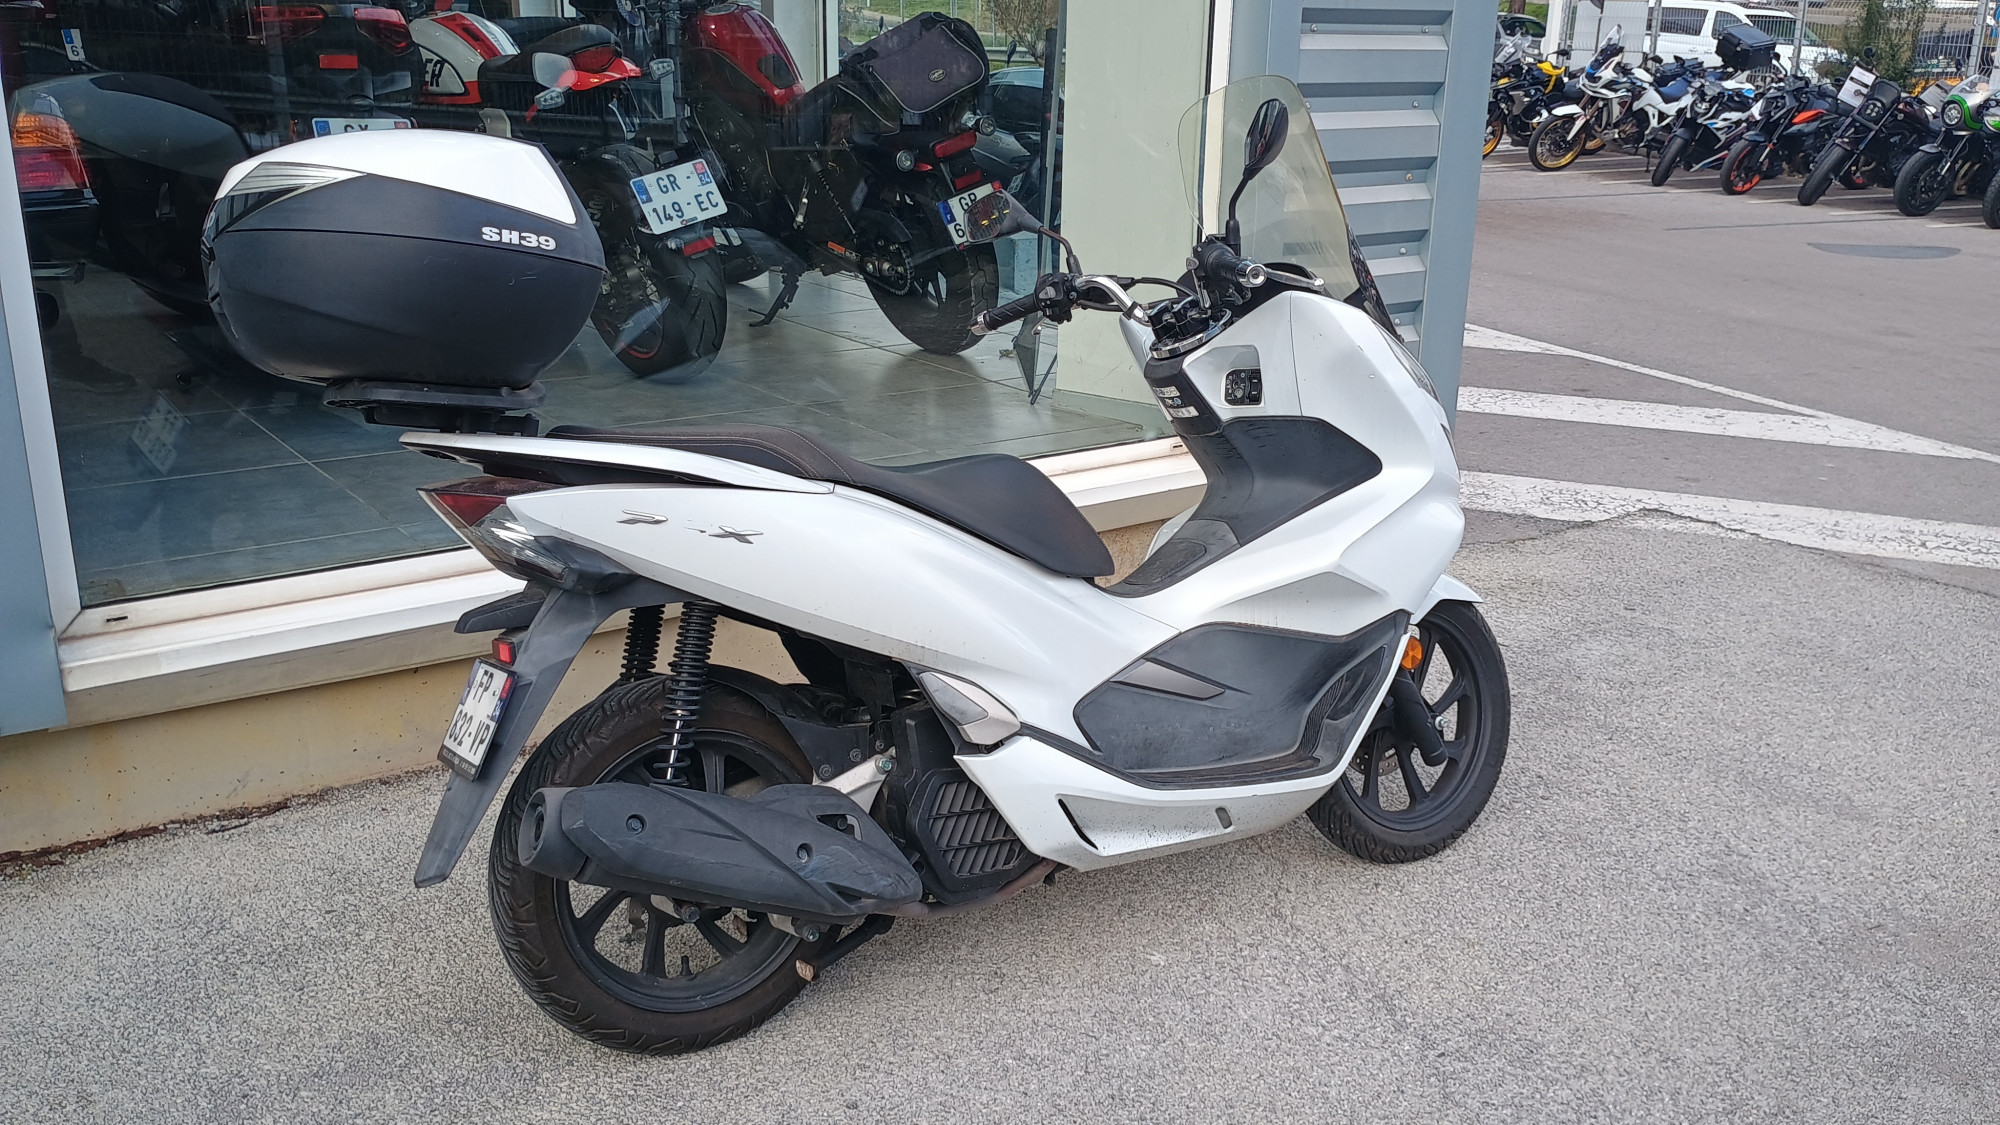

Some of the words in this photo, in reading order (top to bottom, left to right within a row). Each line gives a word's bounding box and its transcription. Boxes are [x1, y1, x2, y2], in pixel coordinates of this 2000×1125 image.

[70, 45, 79, 57] 6
[656, 173, 681, 194] GR
[481, 226, 557, 251] SH39
[954, 223, 965, 238] 6
[472, 669, 494, 703] FP
